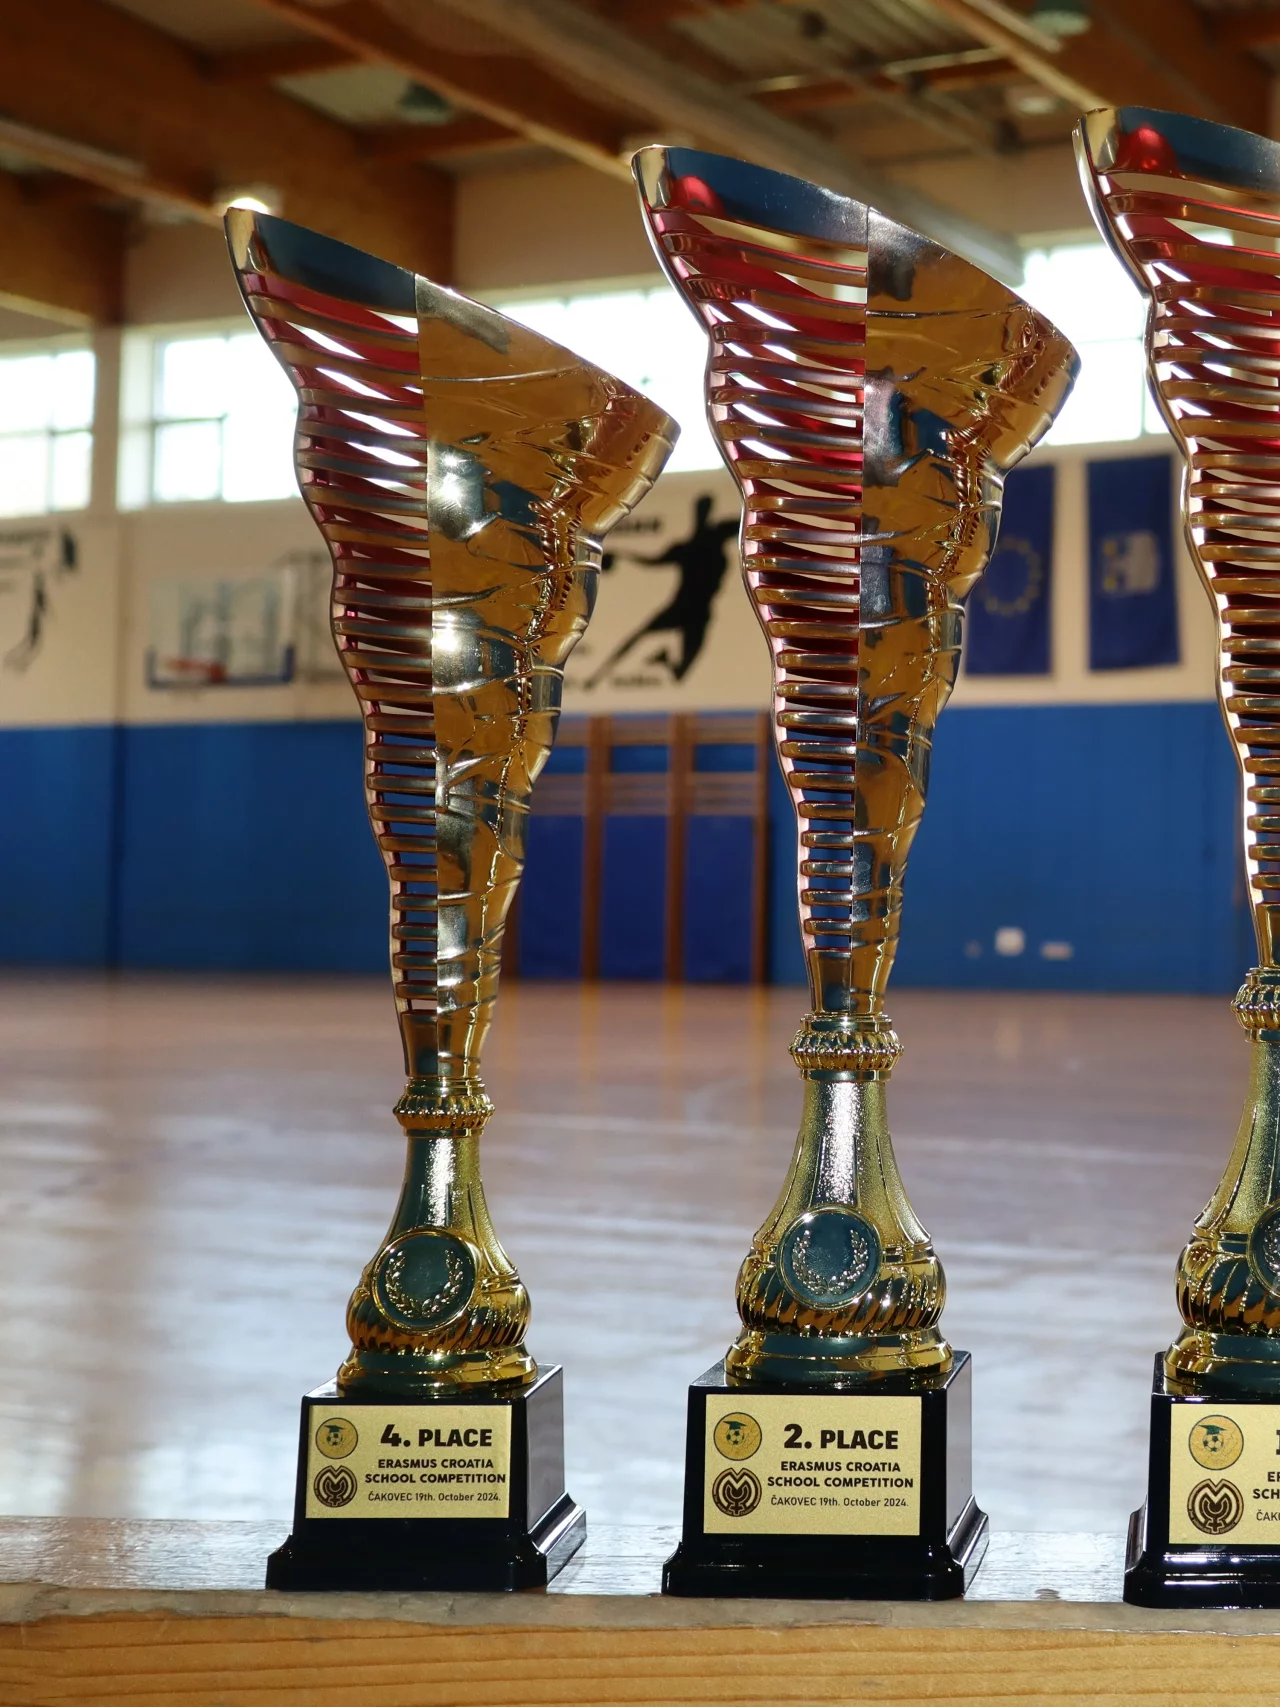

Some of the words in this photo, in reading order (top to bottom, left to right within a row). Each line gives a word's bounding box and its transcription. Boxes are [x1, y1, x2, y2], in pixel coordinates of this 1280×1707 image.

[381, 1424, 411, 1447] 4.
[418, 1429, 492, 1447] PLACE
[784, 1423, 813, 1449] 2.
[820, 1430, 899, 1450] PLACE
[378, 1459, 437, 1469] ERASMUS
[441, 1459, 494, 1469] CROATIA
[780, 1461, 842, 1471] ERASMUS
[846, 1461, 901, 1472] CROATIA
[365, 1474, 416, 1483] SCHOOL
[420, 1474, 506, 1483] COMPETITION
[767, 1477, 820, 1487] SCHOOL
[824, 1477, 914, 1488] COMPETITION
[368, 1490, 412, 1502] ČAKOVEC
[415, 1492, 436, 1502] 19th.
[438, 1492, 475, 1502] October
[477, 1492, 501, 1502] 2024.
[771, 1495, 817, 1506] ČAKOVEC
[820, 1498, 841, 1507] 19th.
[843, 1498, 880, 1507] October
[883, 1498, 909, 1507] 2024.
